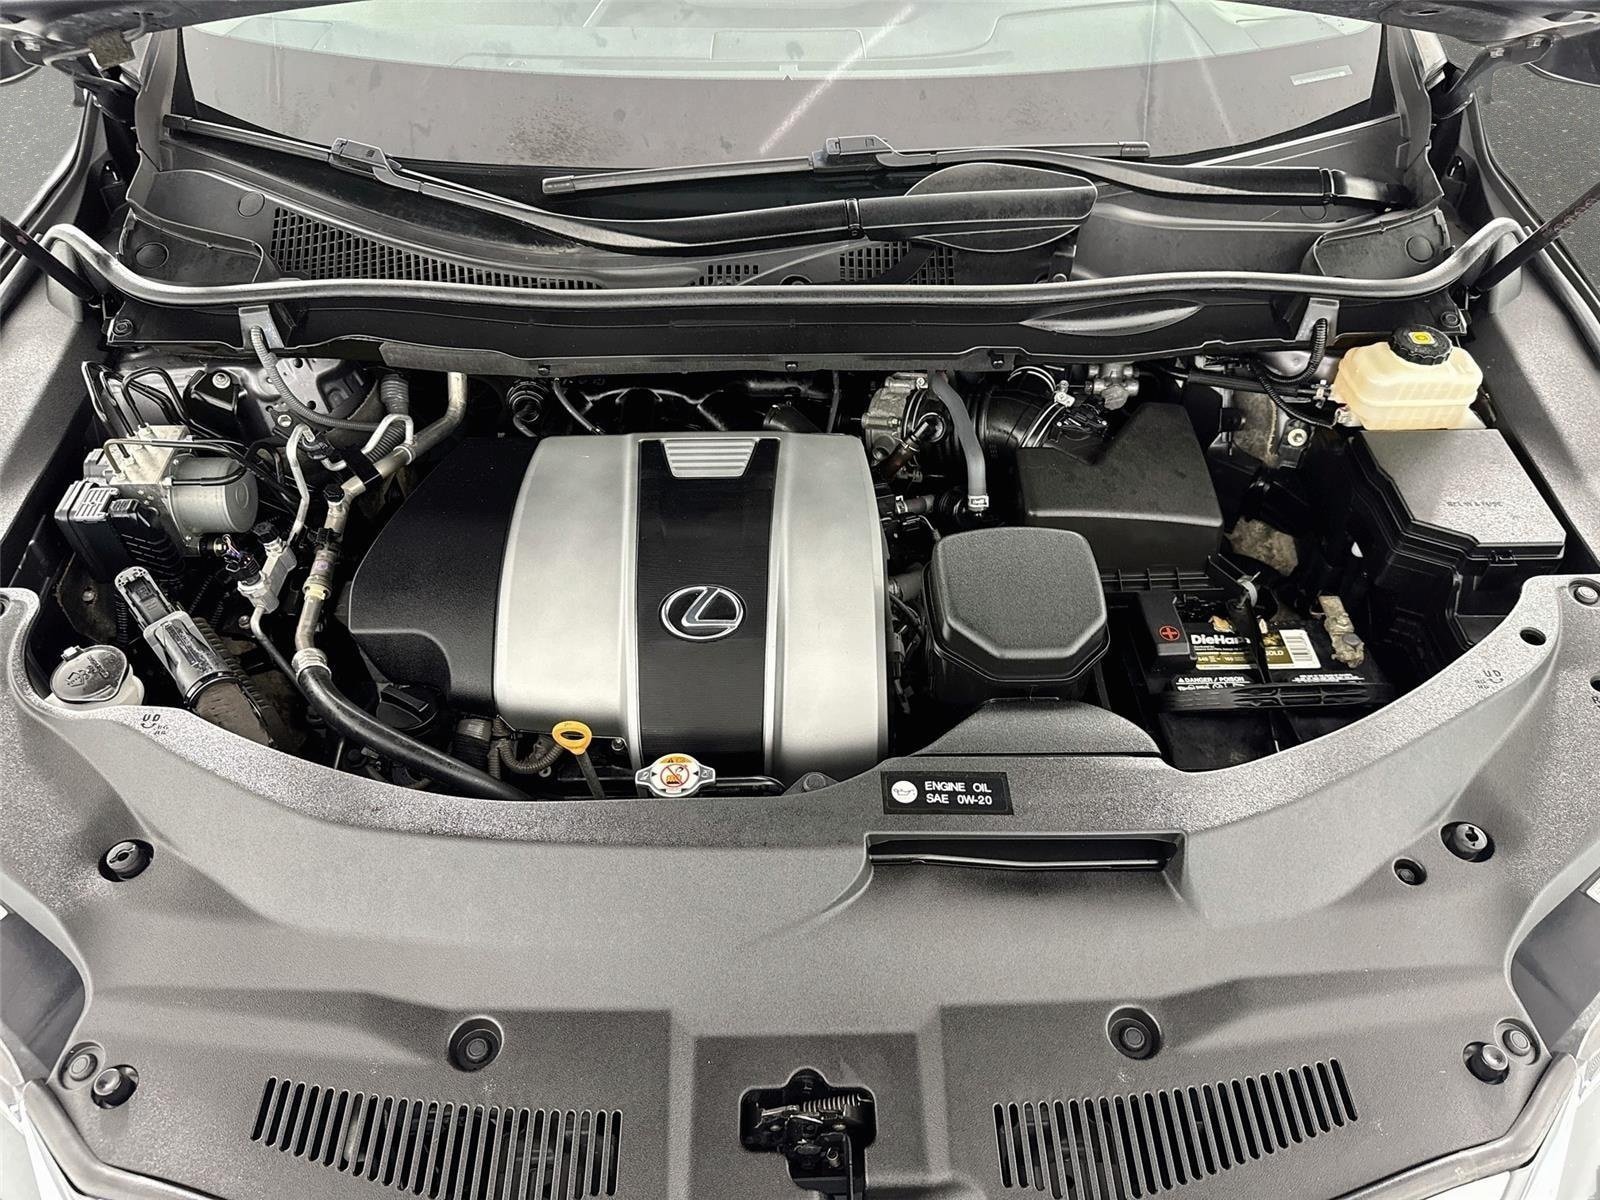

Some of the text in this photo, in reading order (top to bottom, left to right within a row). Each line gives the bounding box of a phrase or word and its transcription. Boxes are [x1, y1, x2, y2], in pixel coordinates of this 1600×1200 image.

[924, 781, 992, 793] ENGINE OIL
[926, 794, 993, 805] SAE 0W-20
